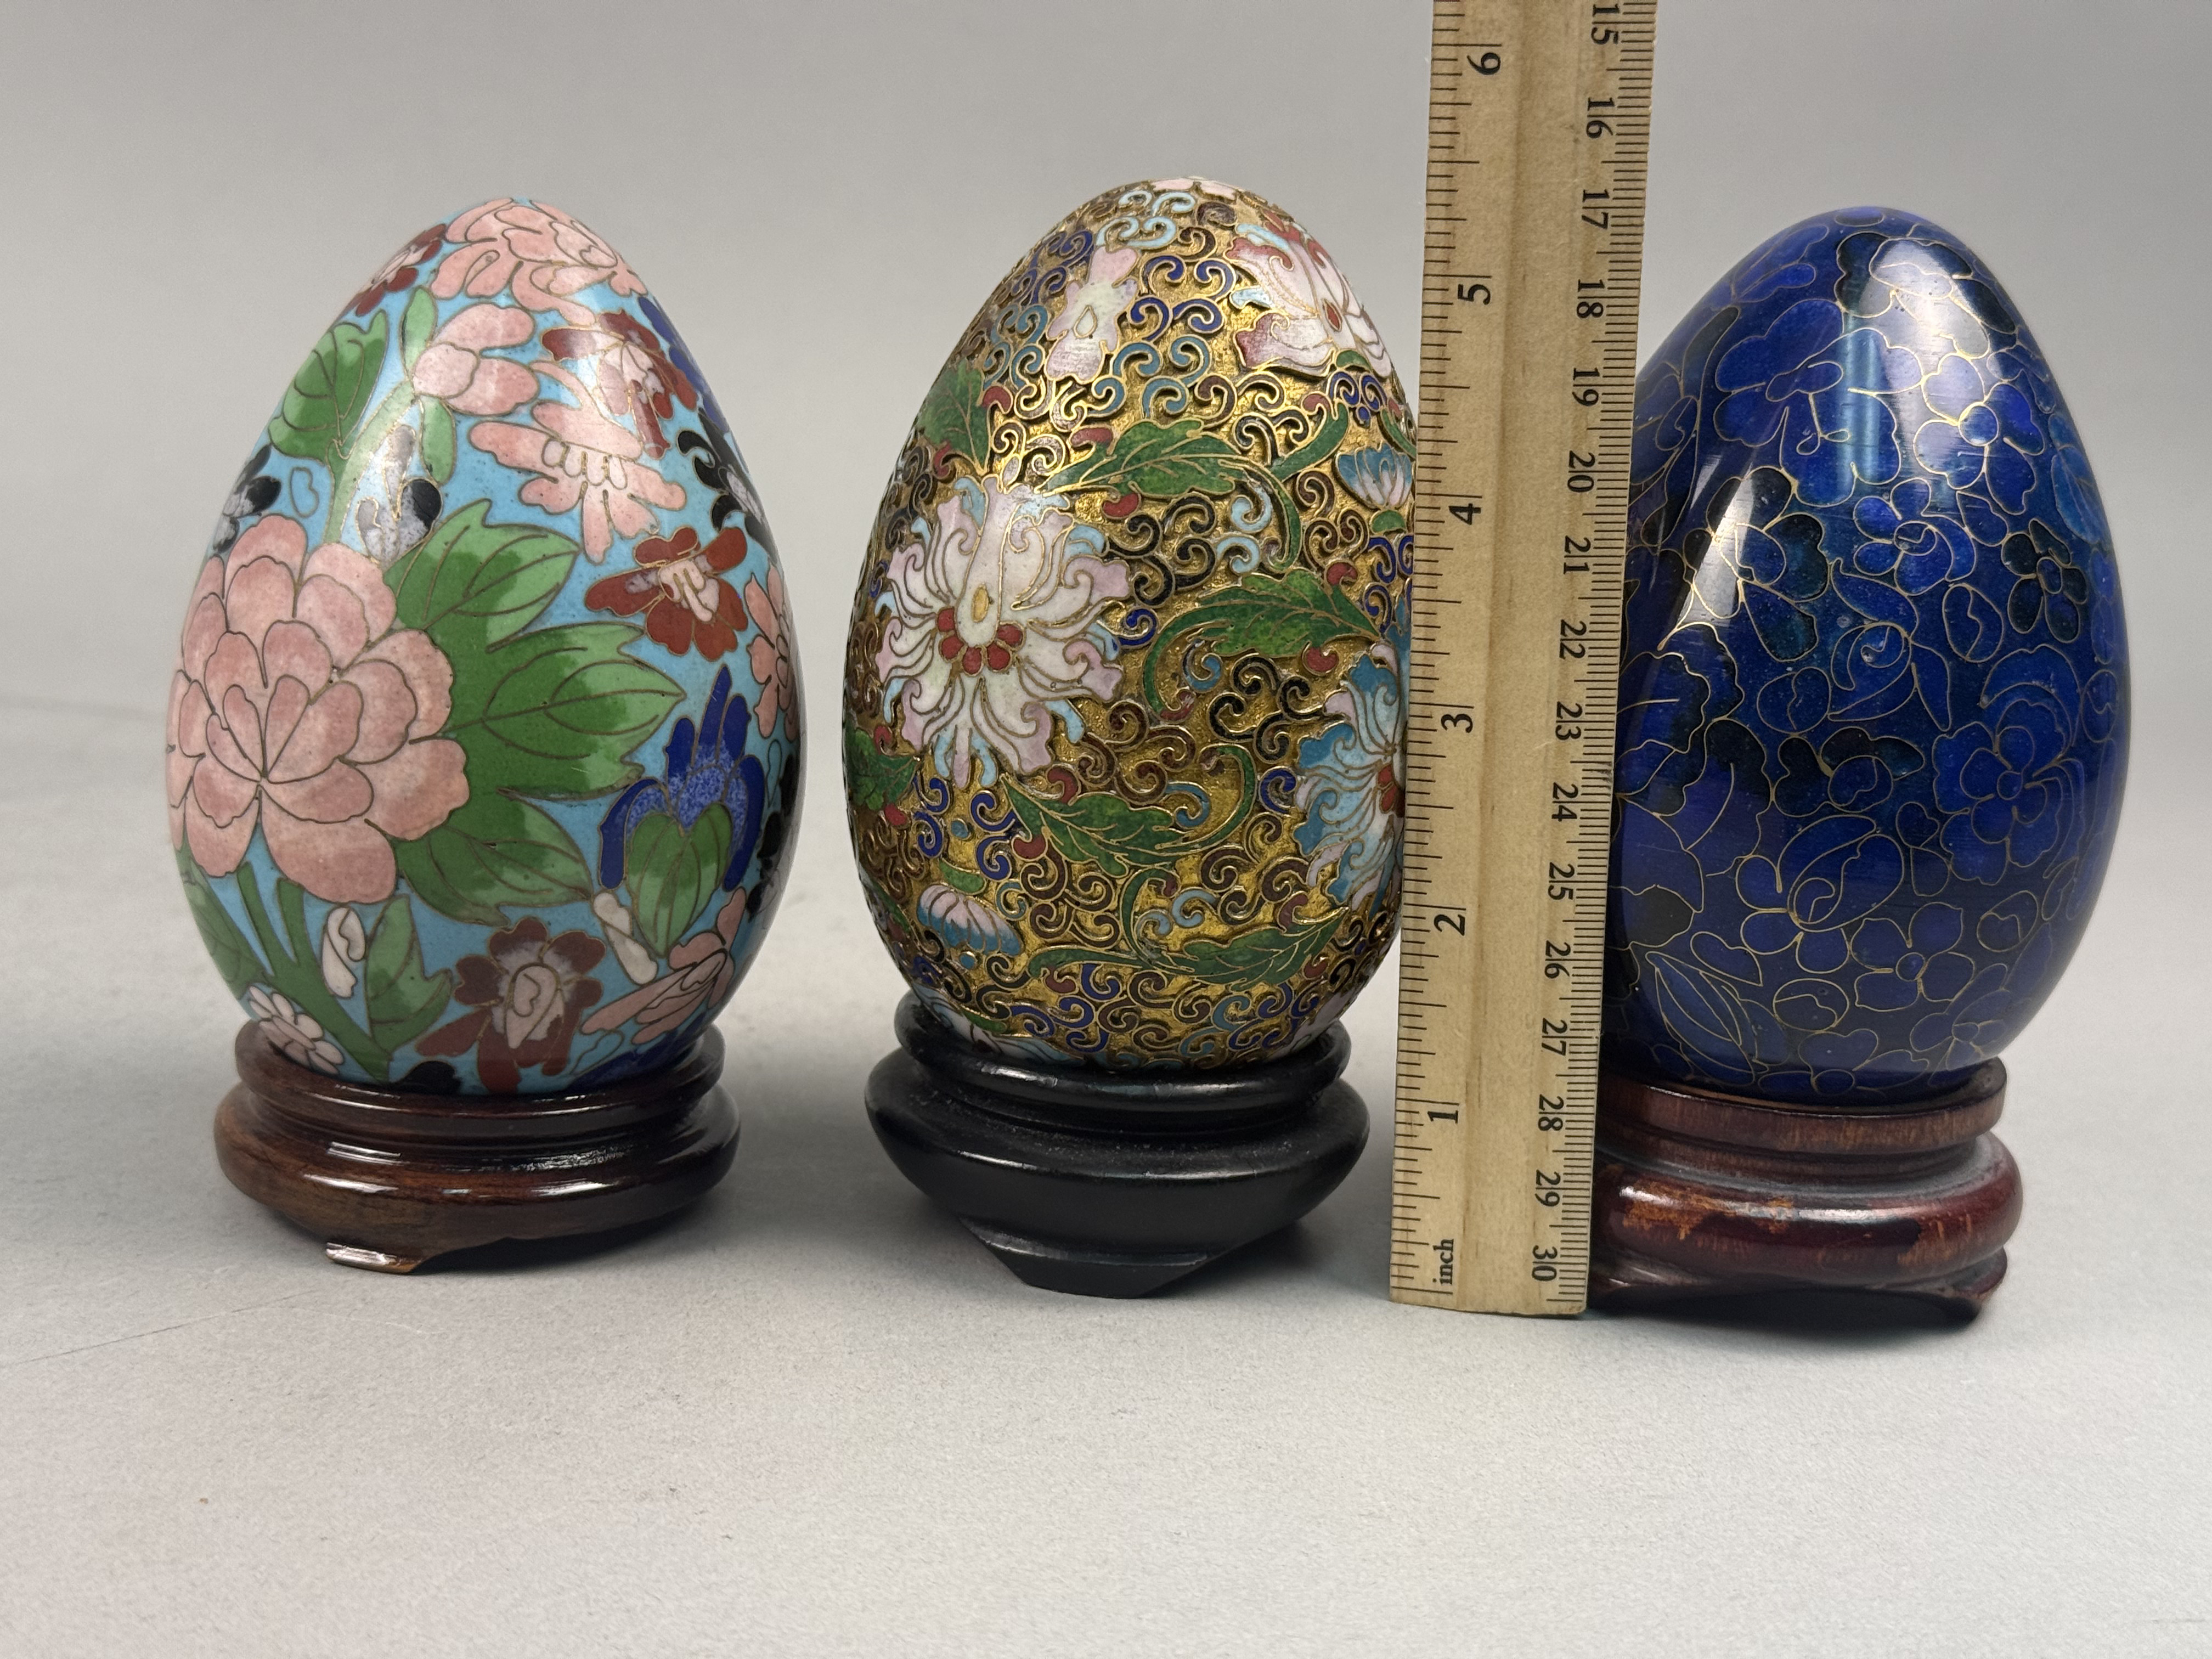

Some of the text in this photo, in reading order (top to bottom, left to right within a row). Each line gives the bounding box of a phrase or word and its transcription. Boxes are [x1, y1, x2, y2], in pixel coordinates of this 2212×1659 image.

[1592, 4, 1620, 45] 15
[1466, 52, 1501, 75] 6
[1586, 97, 1615, 138] 16
[1581, 189, 1610, 229] 17
[1458, 284, 1491, 305] 5
[1576, 279, 1605, 319] 18
[1572, 368, 1600, 407] 19
[1567, 450, 1596, 493] 20
[1449, 503, 1481, 525] 4
[1563, 535, 1592, 574] 21
[1559, 619, 1587, 659] 22
[1441, 714, 1473, 733] 3
[1555, 701, 1583, 741] 23
[1551, 782, 1578, 822] 24
[1548, 862, 1575, 900] 25
[1434, 914, 1465, 936] 2
[1544, 940, 1571, 979] 26
[1542, 1018, 1568, 1056] 27
[1427, 1110, 1458, 1124] 1
[1538, 1094, 1564, 1131] 28
[1535, 1170, 1561, 1207] 29
[1432, 1238, 1454, 1285] inch
[1532, 1245, 1558, 1282] 30
